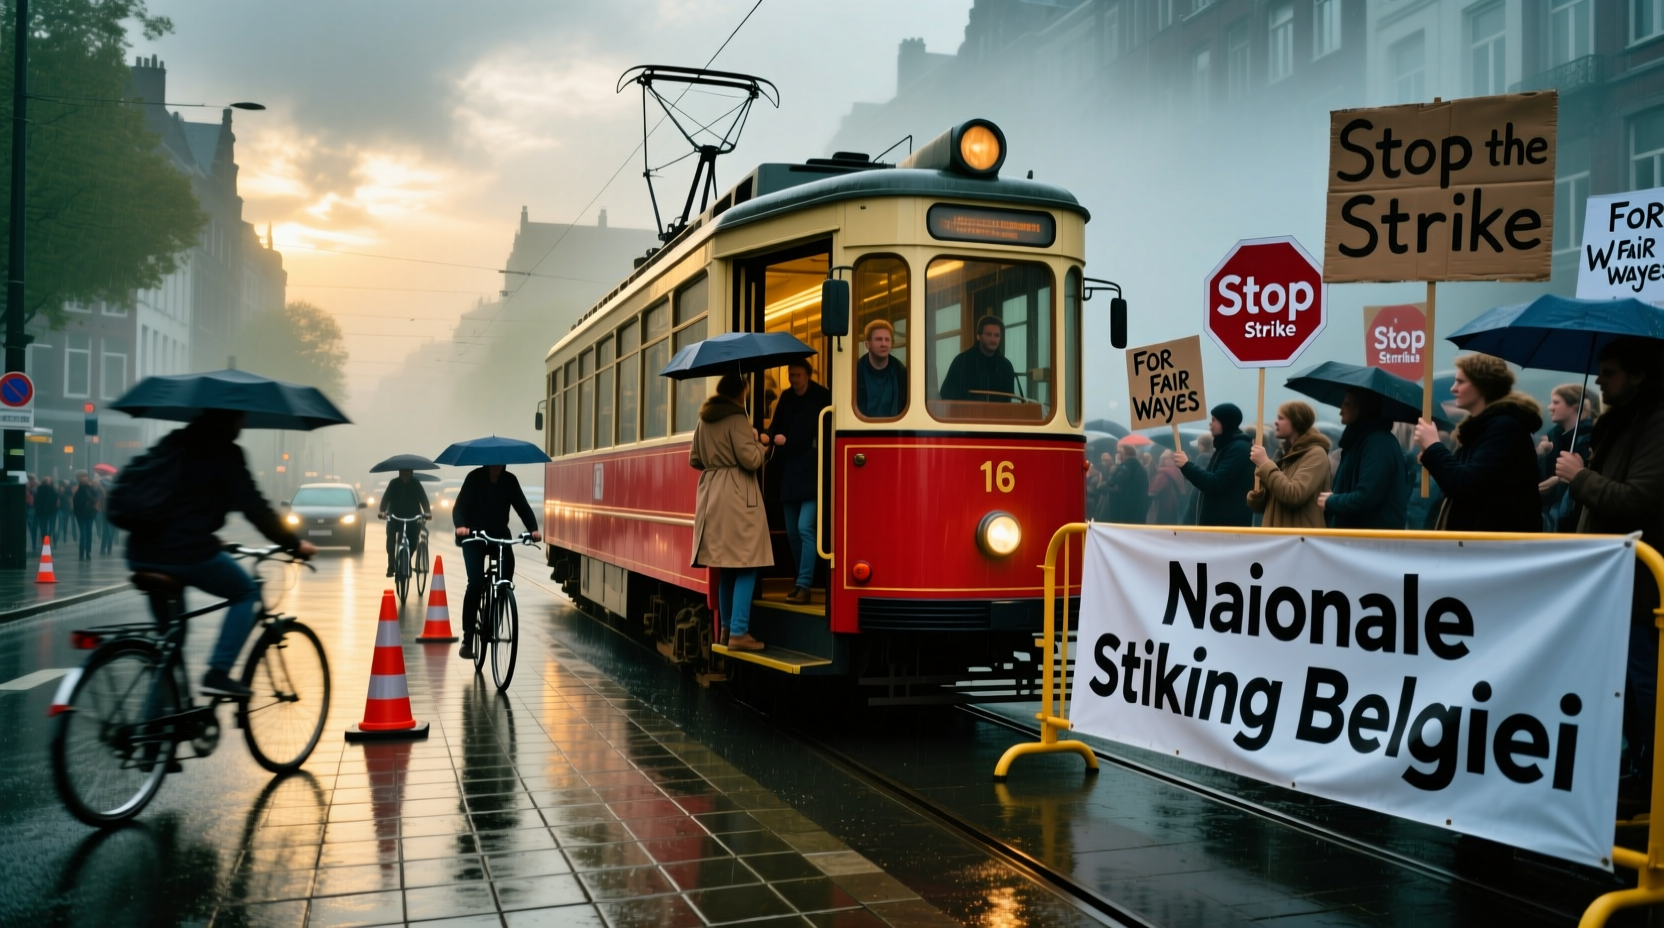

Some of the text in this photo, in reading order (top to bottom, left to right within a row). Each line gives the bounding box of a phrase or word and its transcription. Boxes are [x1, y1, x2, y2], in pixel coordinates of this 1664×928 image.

[1337, 119, 1549, 188] Stop the
[1338, 188, 1542, 258] Strike
[1217, 274, 1315, 321] Stop
[1244, 320, 1297, 339] Strike
[1374, 325, 1426, 354] Stop
[1133, 349, 1174, 376] FOR
[1150, 370, 1190, 395] FAIR
[980, 460, 1016, 493] 16
[1162, 560, 1475, 661] Naionale
[1089, 633, 1583, 792] Stiking Belgiei
